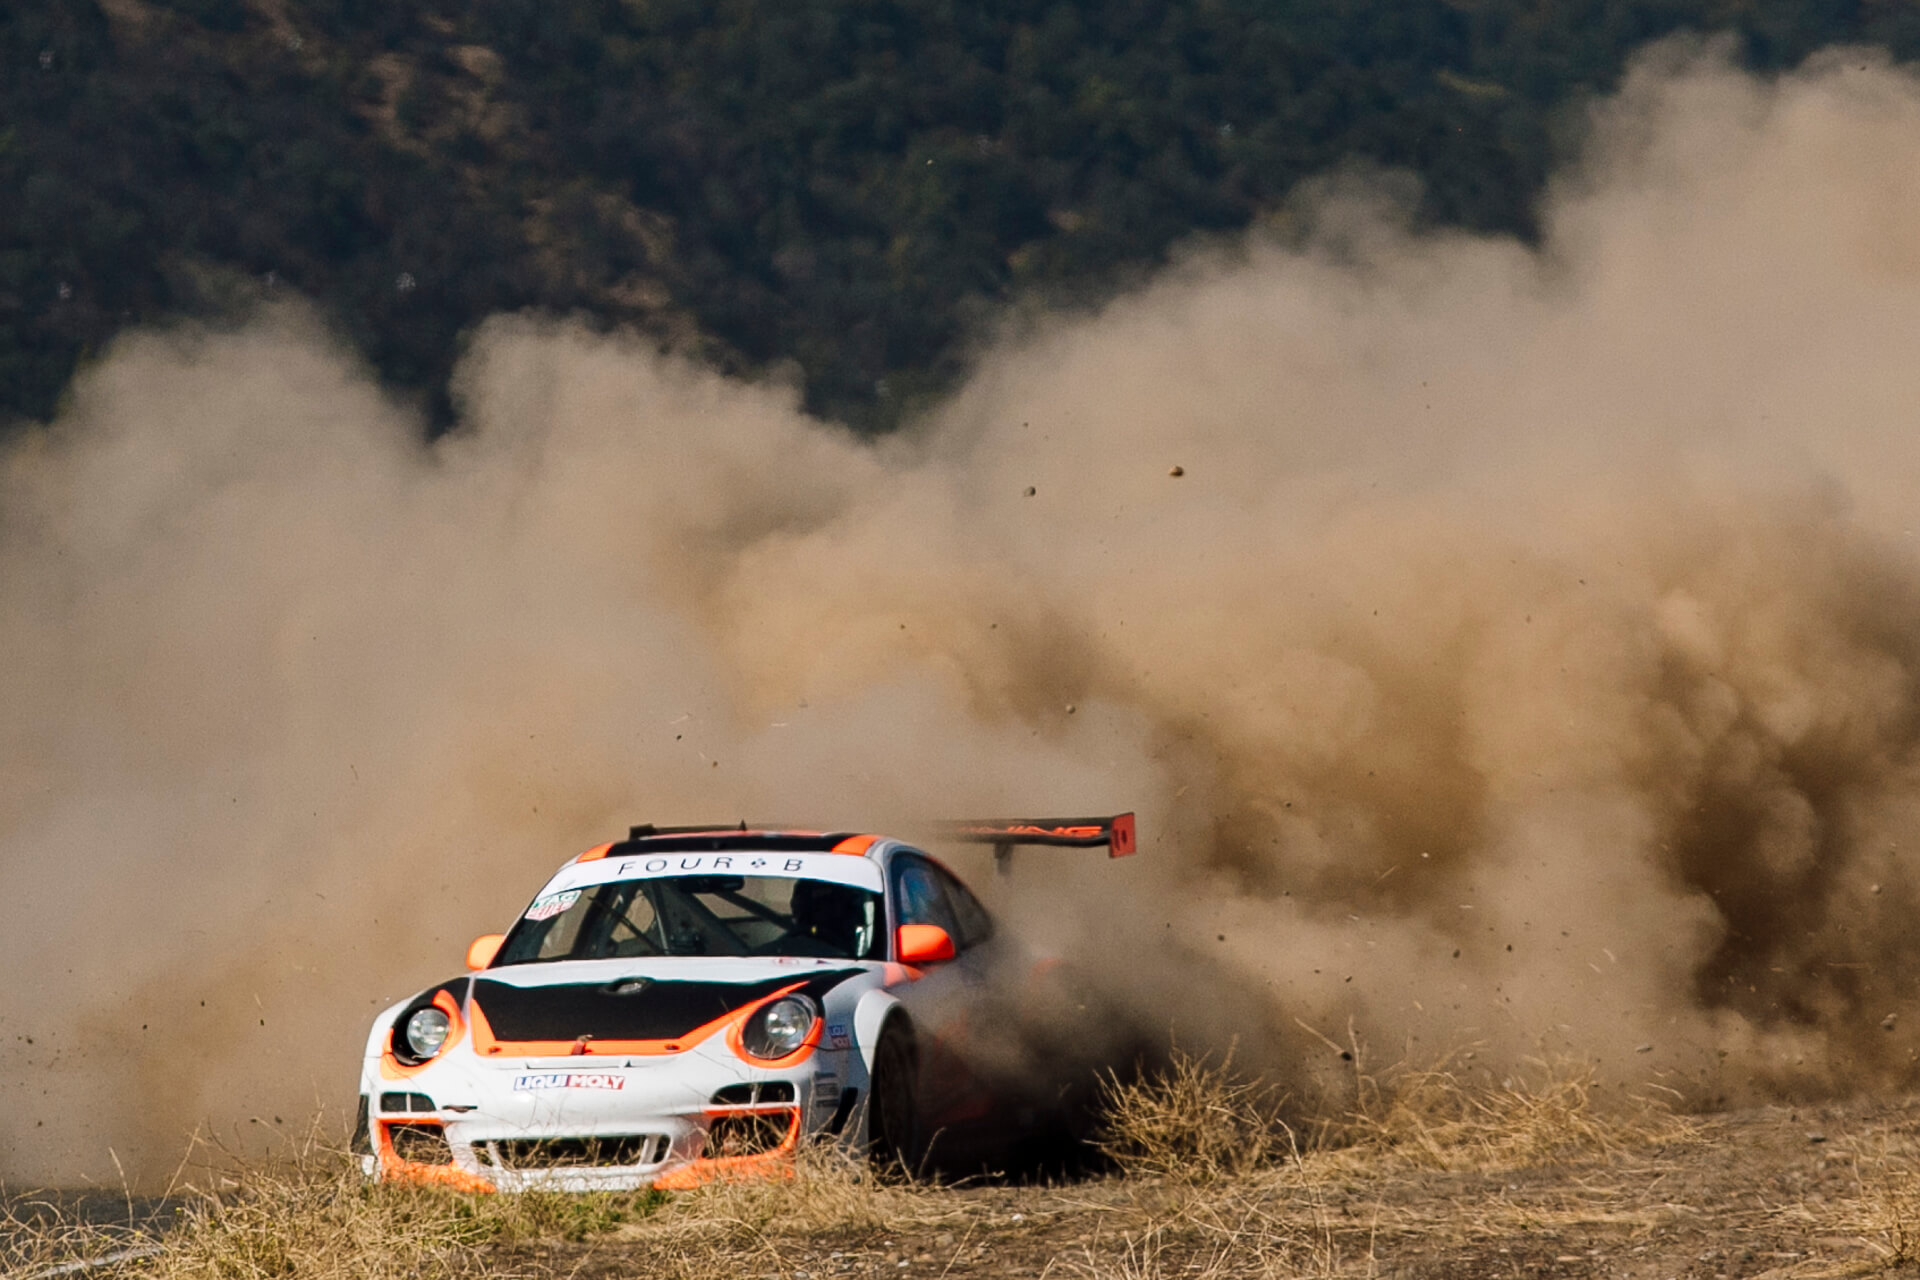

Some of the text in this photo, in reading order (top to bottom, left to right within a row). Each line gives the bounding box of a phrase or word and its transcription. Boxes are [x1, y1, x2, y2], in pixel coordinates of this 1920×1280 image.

[617, 856, 803, 875] FOUR B
[515, 1075, 625, 1091] LIQUI MOLY
